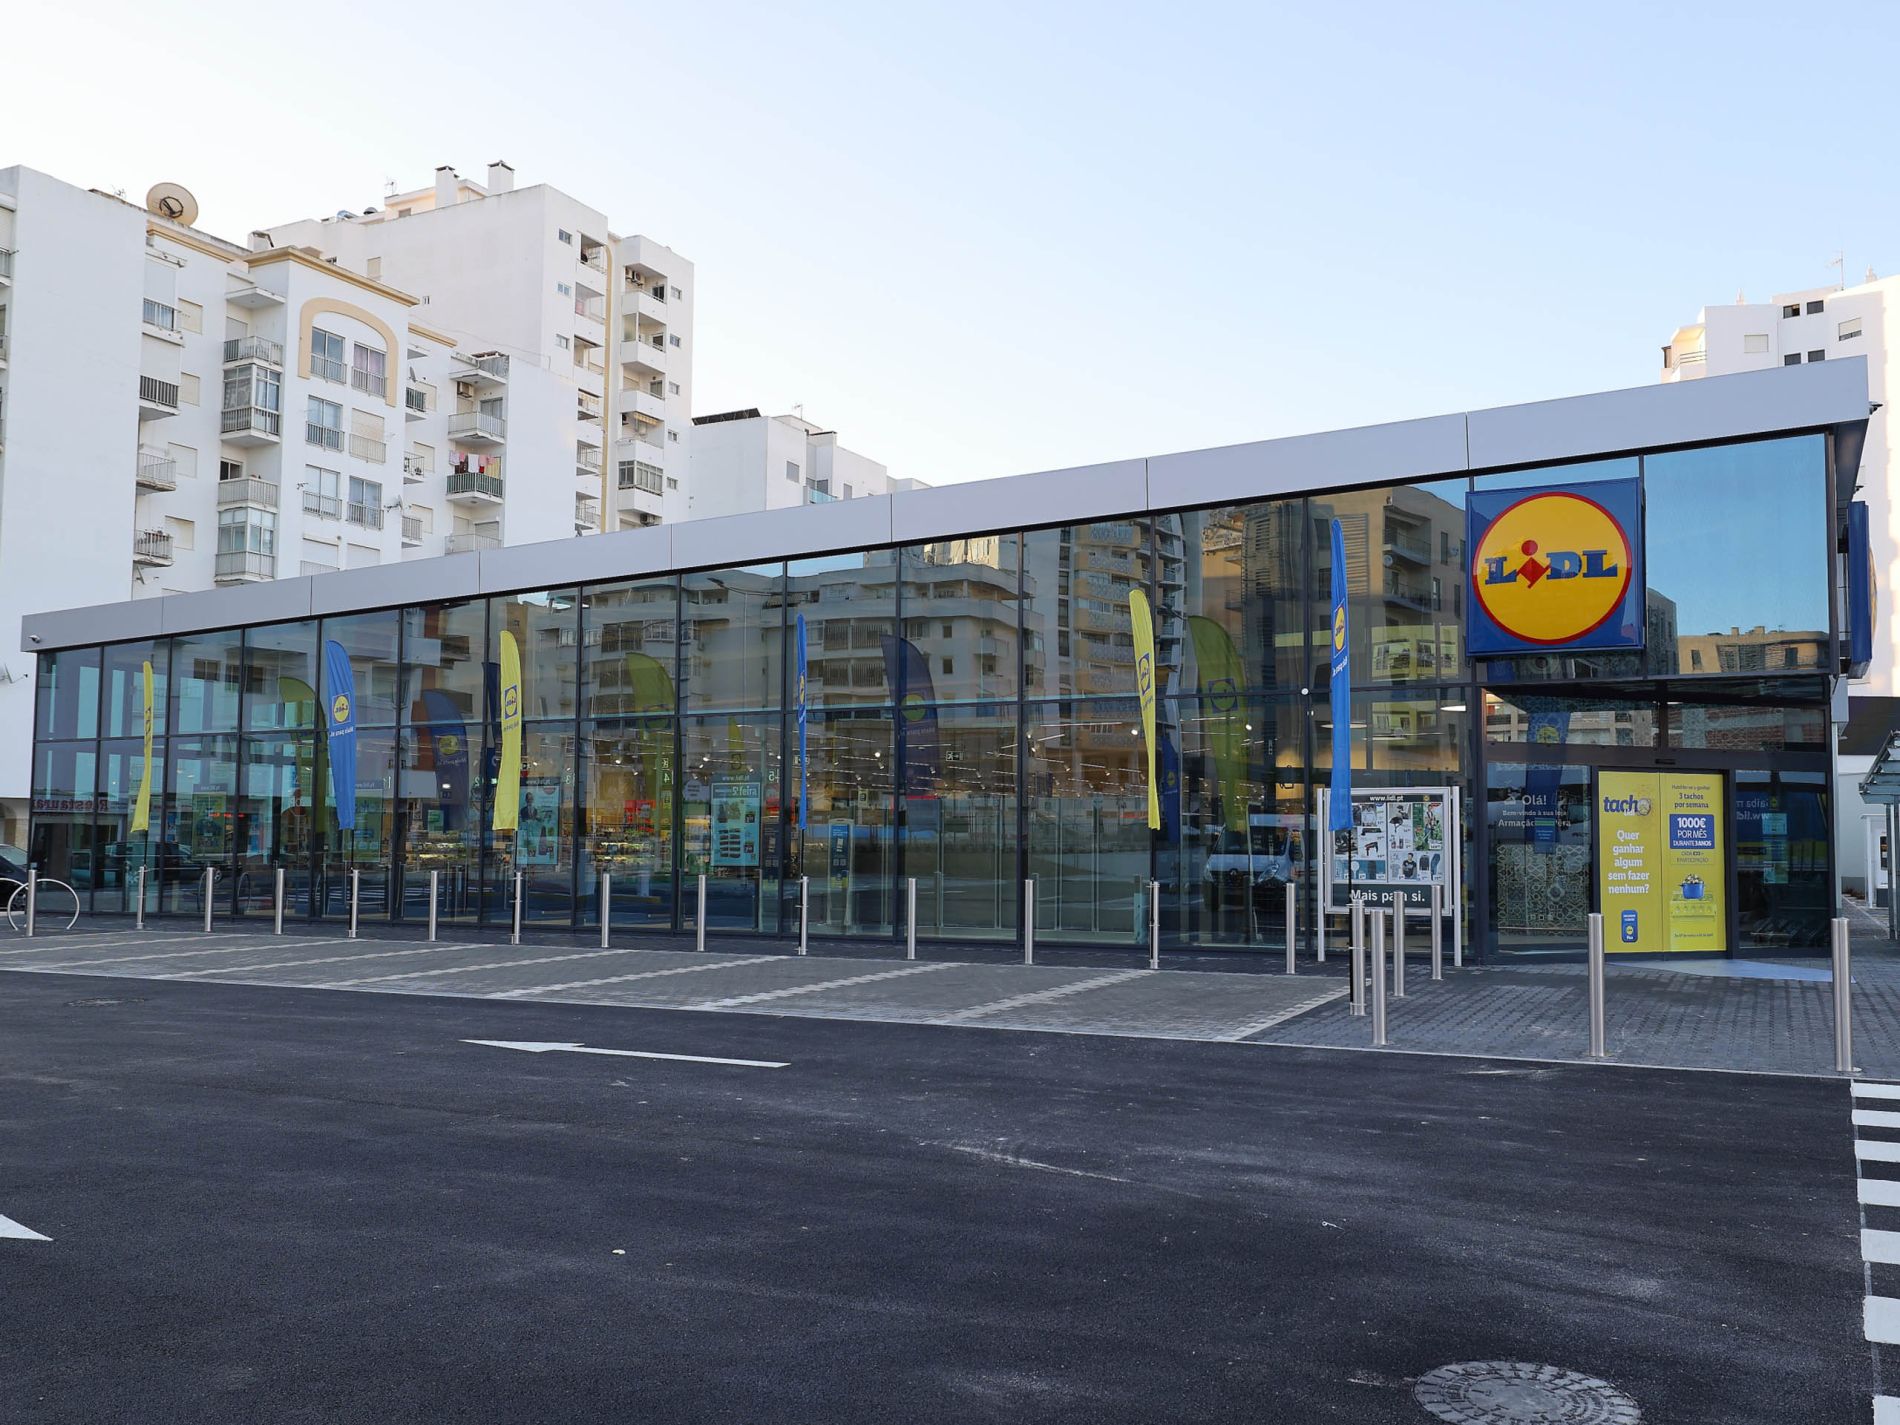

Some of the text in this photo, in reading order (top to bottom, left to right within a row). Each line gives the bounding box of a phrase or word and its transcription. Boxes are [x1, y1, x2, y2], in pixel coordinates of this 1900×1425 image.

[1369, 794, 1404, 802] www.lidl.pt
[1522, 794, 1547, 806] Olá!
[1684, 792, 1704, 800] tachos
[1674, 802, 1685, 810] por
[1677, 817, 1706, 829] 1000€
[1616, 830, 1639, 842] Quer
[1677, 829, 1707, 839] POR MÊS
[1612, 843, 1645, 855] ganhar
[1614, 857, 1643, 869] algum
[1607, 870, 1650, 881] sem fazer
[1608, 884, 1650, 894] nenhum?
[1350, 889, 1378, 901] Mais
[1411, 890, 1425, 902] si.
